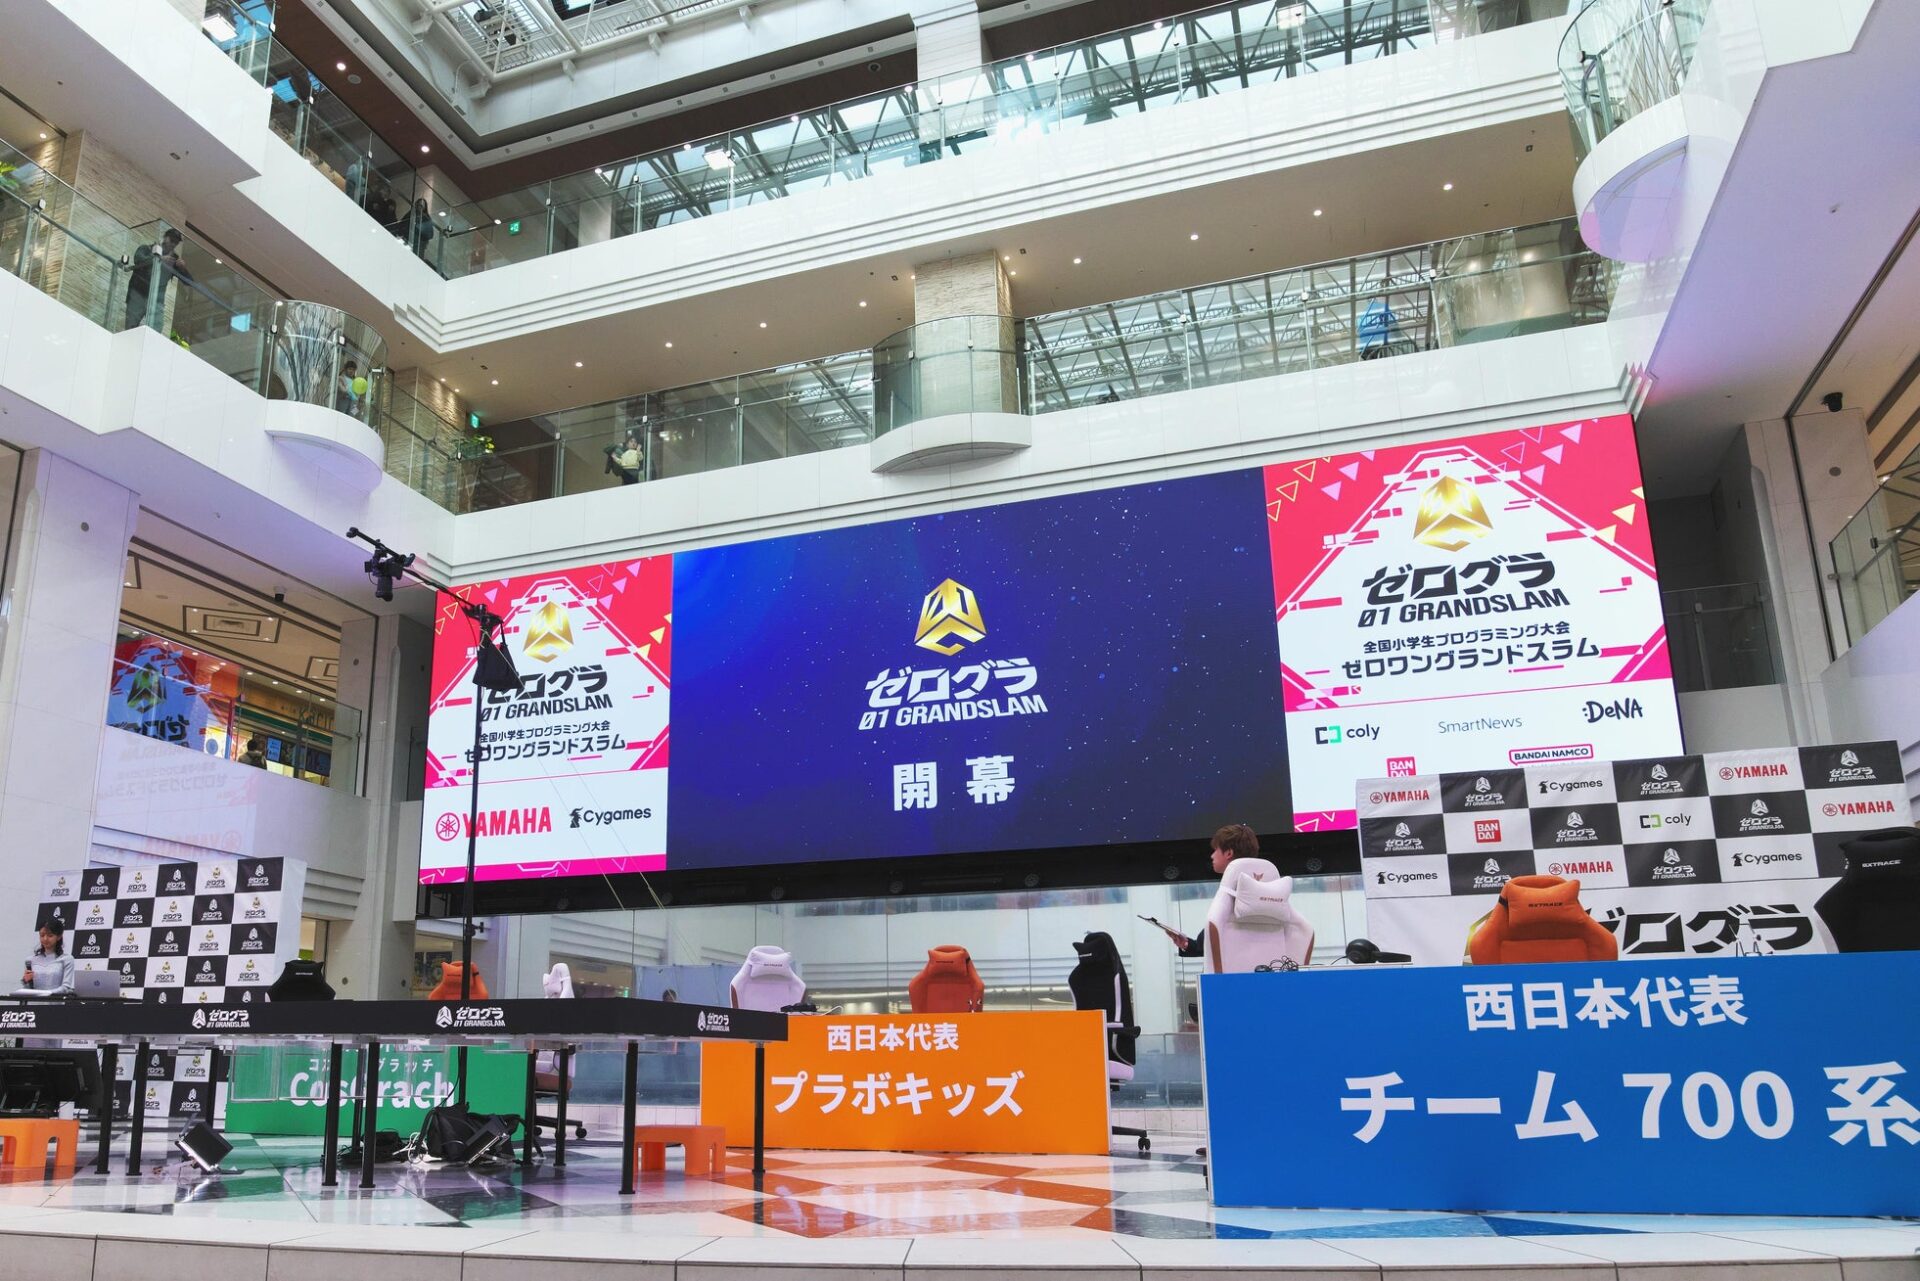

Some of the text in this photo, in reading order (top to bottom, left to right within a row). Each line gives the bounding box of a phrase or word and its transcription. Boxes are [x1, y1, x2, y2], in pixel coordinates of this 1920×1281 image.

[1362, 552, 1555, 605] ゼログラ
[1399, 588, 1570, 623] GRANDSLAM
[1363, 621, 1570, 654] 全国小学生プログラミング大会
[1341, 637, 1600, 679] ゼロワングランドスラム
[865, 657, 1038, 708] ゼログラ
[505, 694, 613, 720] GRANDSLAM
[895, 695, 1048, 727] GRANDSLAM
[480, 720, 611, 744] 全国小学生プログラミング大会
[1346, 724, 1380, 740] coly
[1438, 715, 1522, 734] SmartNews
[1514, 748, 1589, 761] BANDAI NAMCO
[1390, 760, 1413, 770] BAN
[1735, 764, 1788, 778] YAMAHA
[1550, 780, 1603, 792] Cygames
[1384, 790, 1429, 803] YAMAHA
[1838, 800, 1895, 815] YAMAHA
[462, 807, 552, 838] YAMAHA
[583, 807, 652, 826] Cygames
[1665, 813, 1691, 826] coly
[1477, 823, 1499, 832] BAN
[1478, 832, 1495, 840] DAI
[1744, 852, 1802, 865] Cygames
[1563, 861, 1613, 874] YAMAHA
[1387, 872, 1438, 884] Cygames
[1462, 974, 1749, 1031] 西日本代表
[1, 1011, 36, 1022] ゼログラ
[208, 1009, 250, 1021] ゼログラ
[456, 1006, 504, 1020] ゼログラ
[707, 1012, 730, 1026] ゼログラ
[827, 1022, 960, 1051] 西日本代表
[771, 1070, 1025, 1117] プラボキッズ
[1340, 1061, 1920, 1147] チーム 700 系
